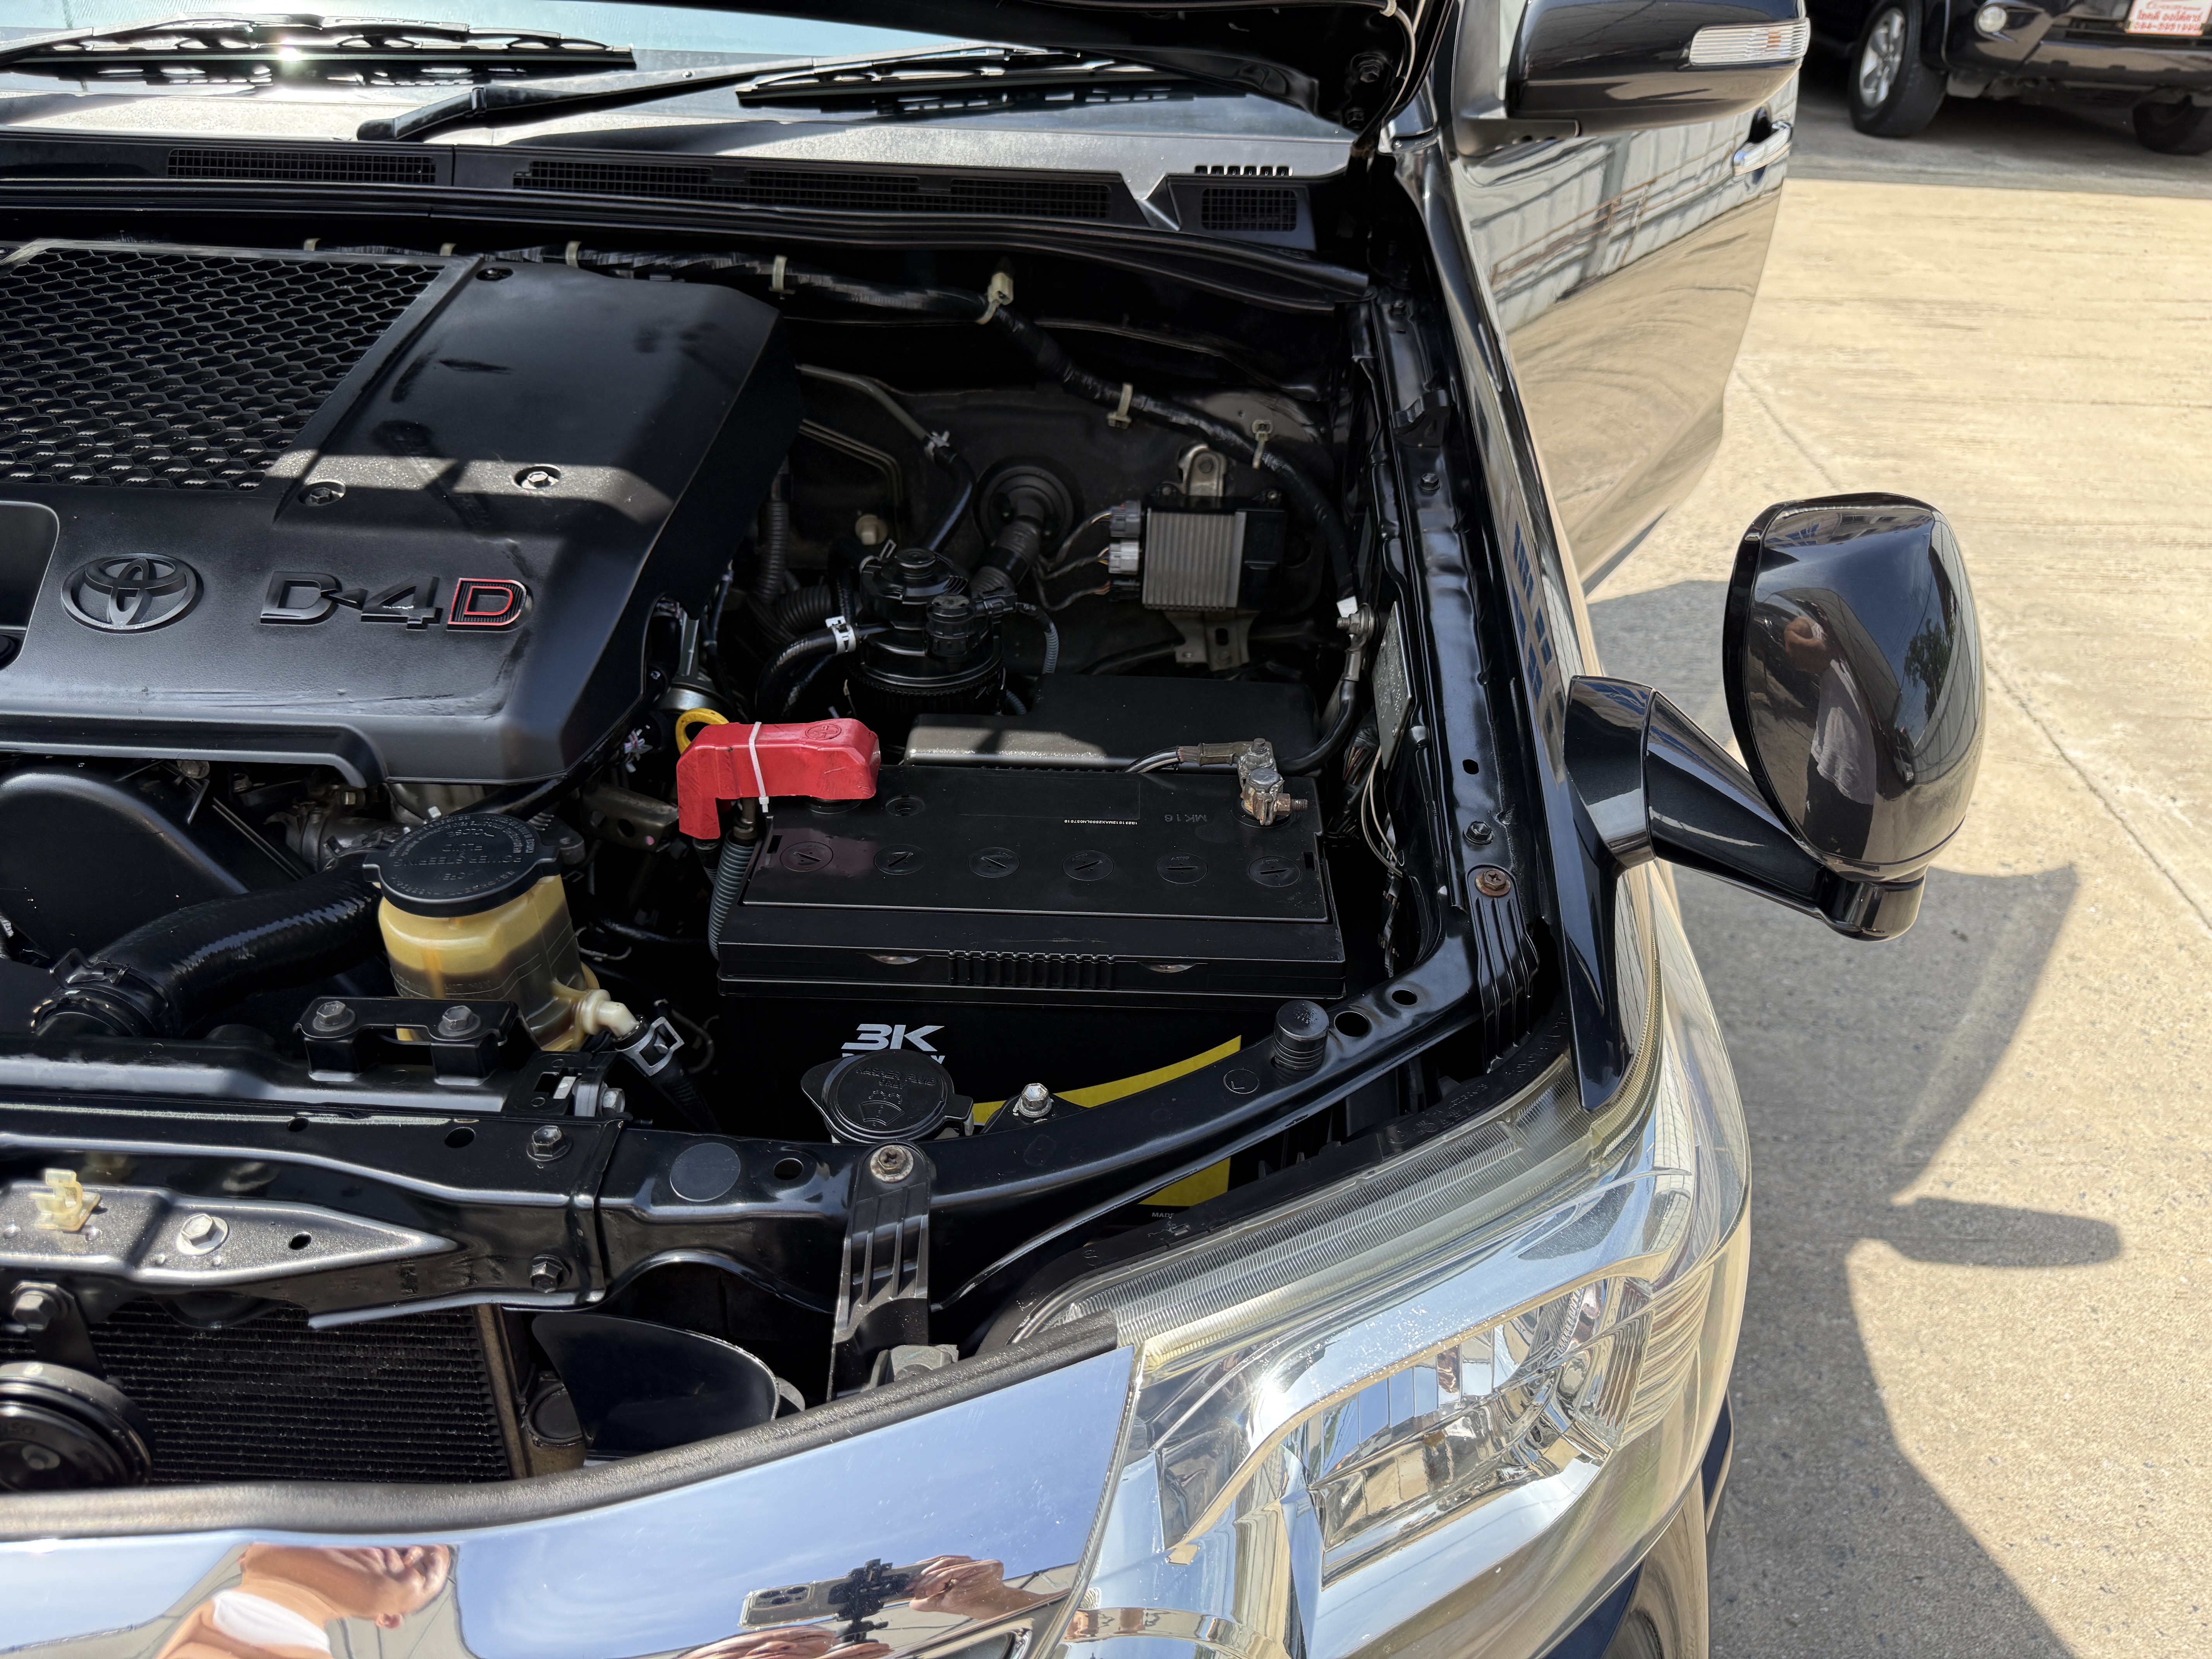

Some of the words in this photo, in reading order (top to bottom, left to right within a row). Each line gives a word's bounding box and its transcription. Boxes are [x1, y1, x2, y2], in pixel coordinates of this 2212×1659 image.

[447, 828, 484, 838] CLOSE
[443, 843, 483, 852] FLUID
[393, 855, 466, 867] STEERING
[469, 855, 521, 863] POWER
[841, 1024, 945, 1052] 3K
[856, 1065, 901, 1080] WASHER
[905, 1074, 937, 1085] FLUID
[879, 1078, 907, 1089] ONLY
